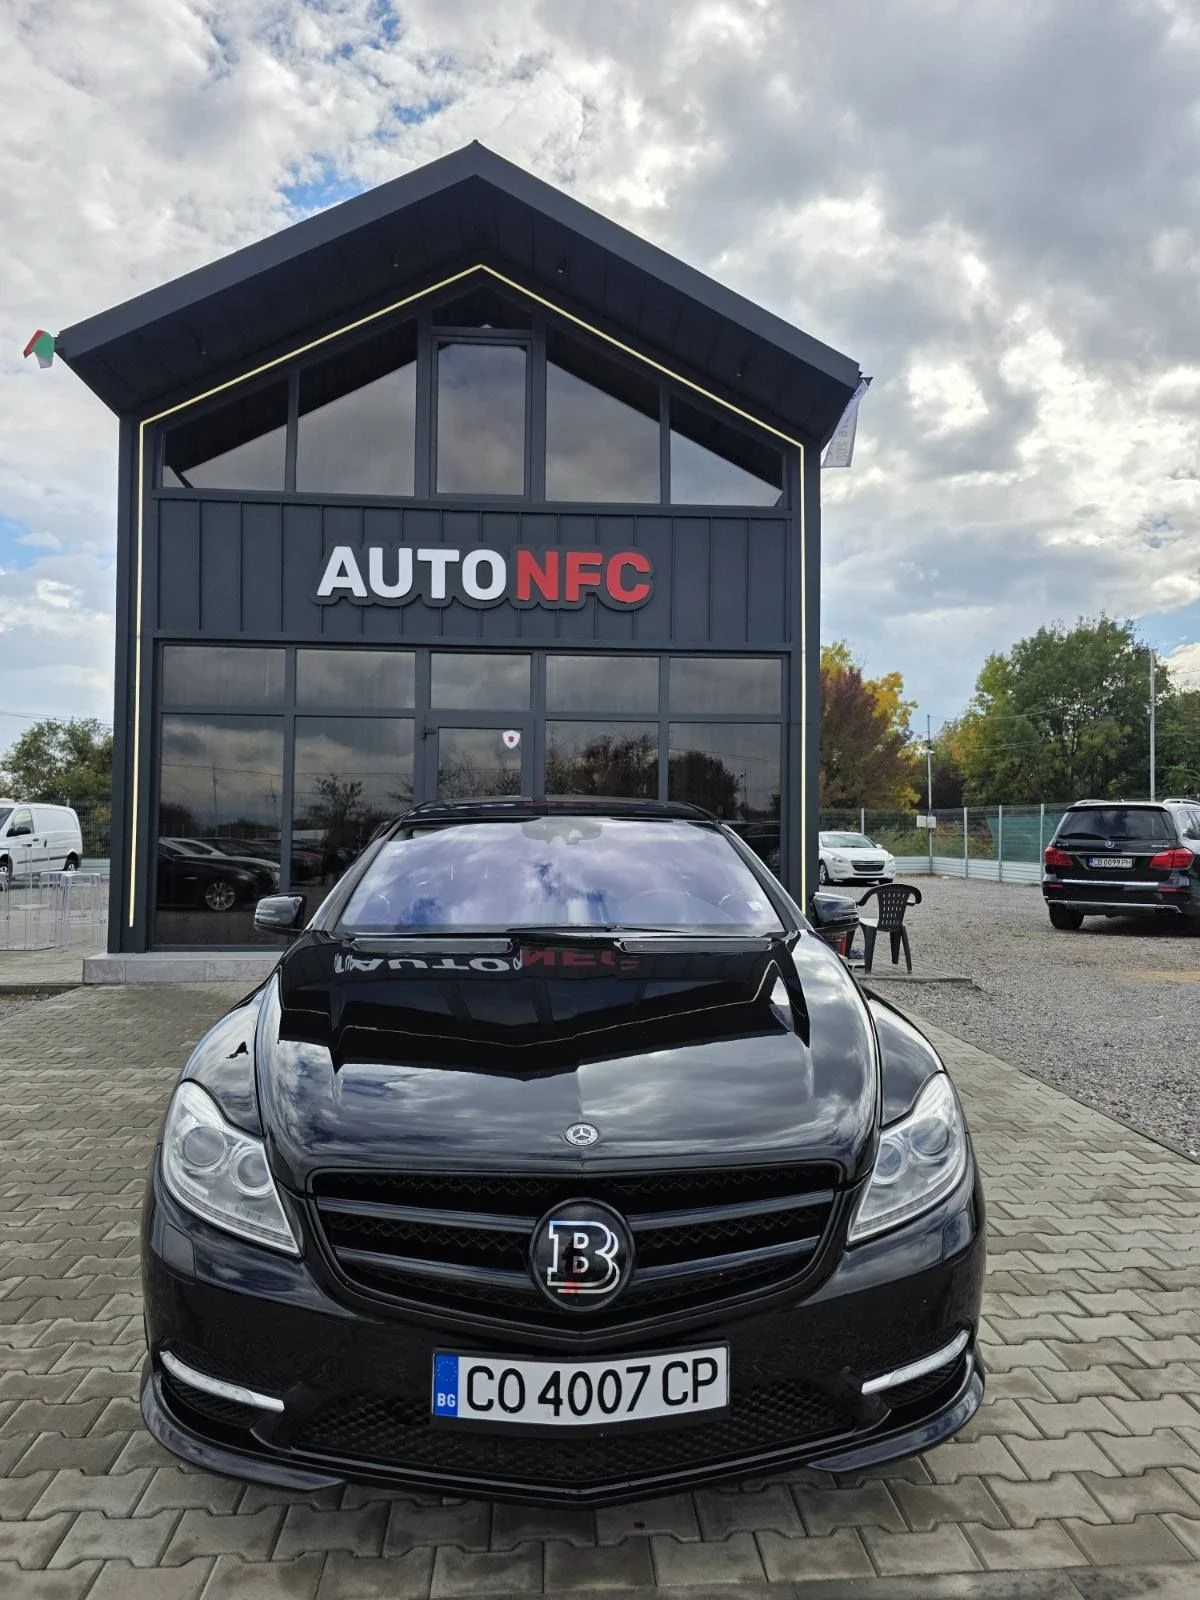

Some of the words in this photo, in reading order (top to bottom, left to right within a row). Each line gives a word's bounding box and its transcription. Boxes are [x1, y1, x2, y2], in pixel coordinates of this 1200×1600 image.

[437, 1392, 456, 1408] BG
[466, 1365, 526, 1414] CO
[537, 1364, 652, 1418] 4007
[661, 1356, 719, 1407] CP
